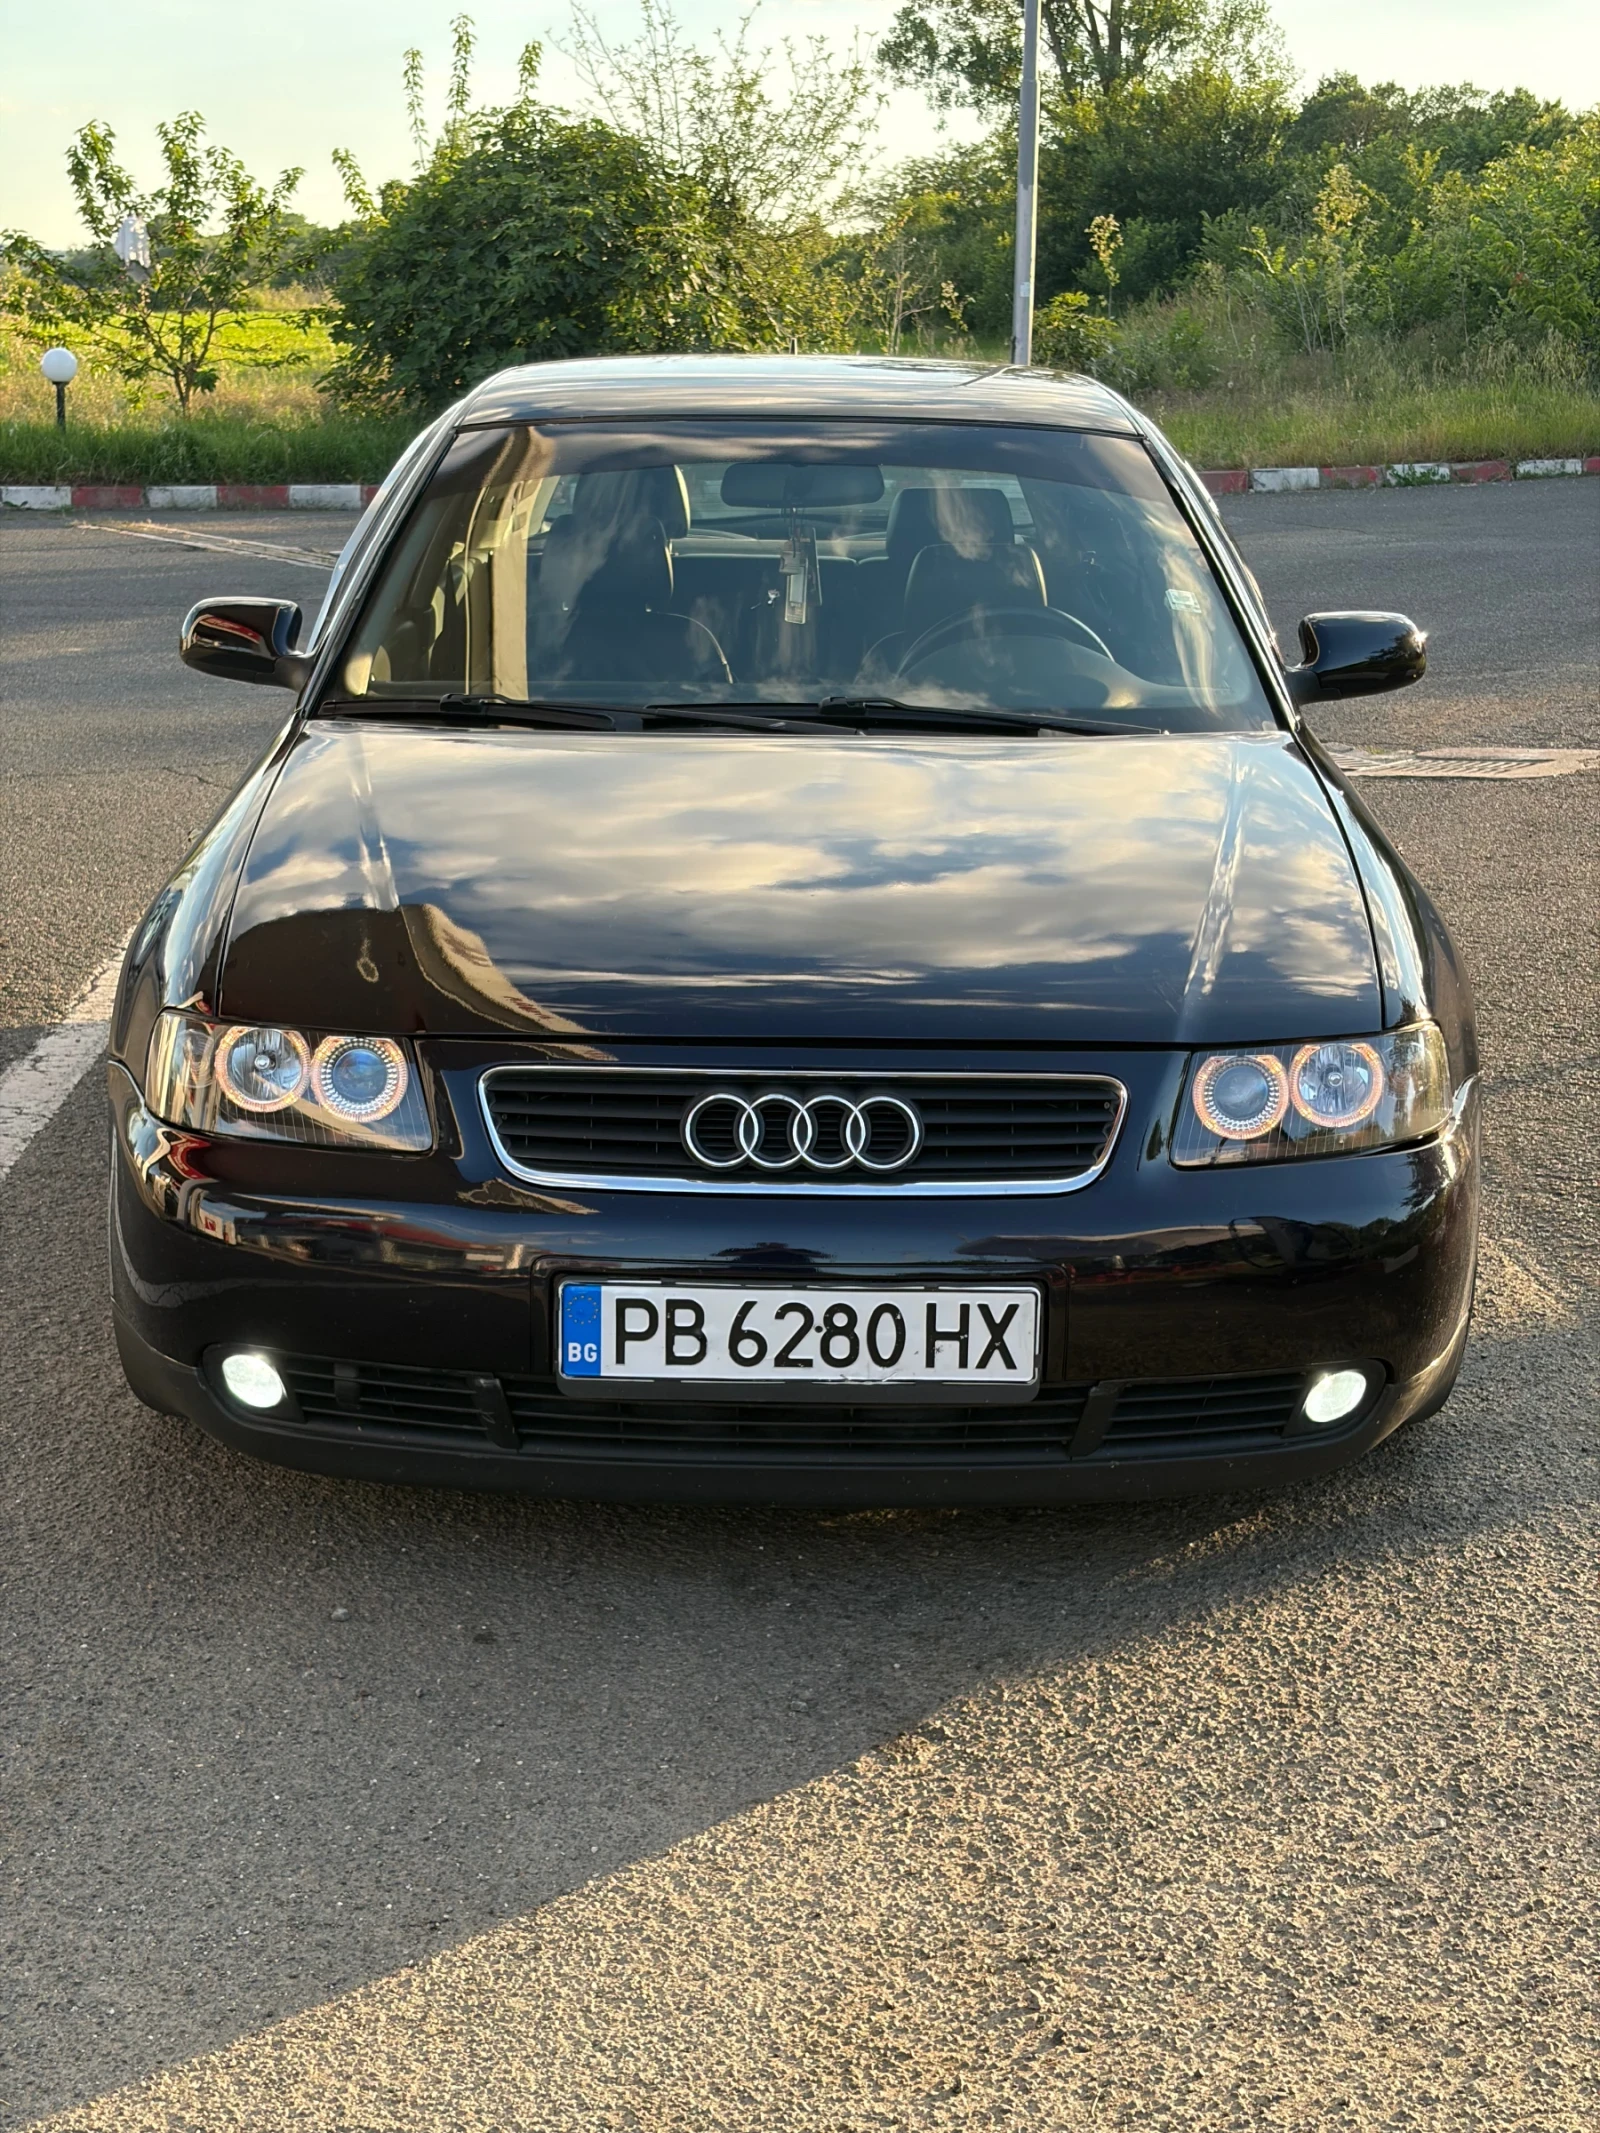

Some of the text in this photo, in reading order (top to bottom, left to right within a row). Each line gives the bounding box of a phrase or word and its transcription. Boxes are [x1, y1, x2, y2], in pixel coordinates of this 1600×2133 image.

[567, 1342, 598, 1362] BG
[615, 1297, 1020, 1370] PB 6280 HX
